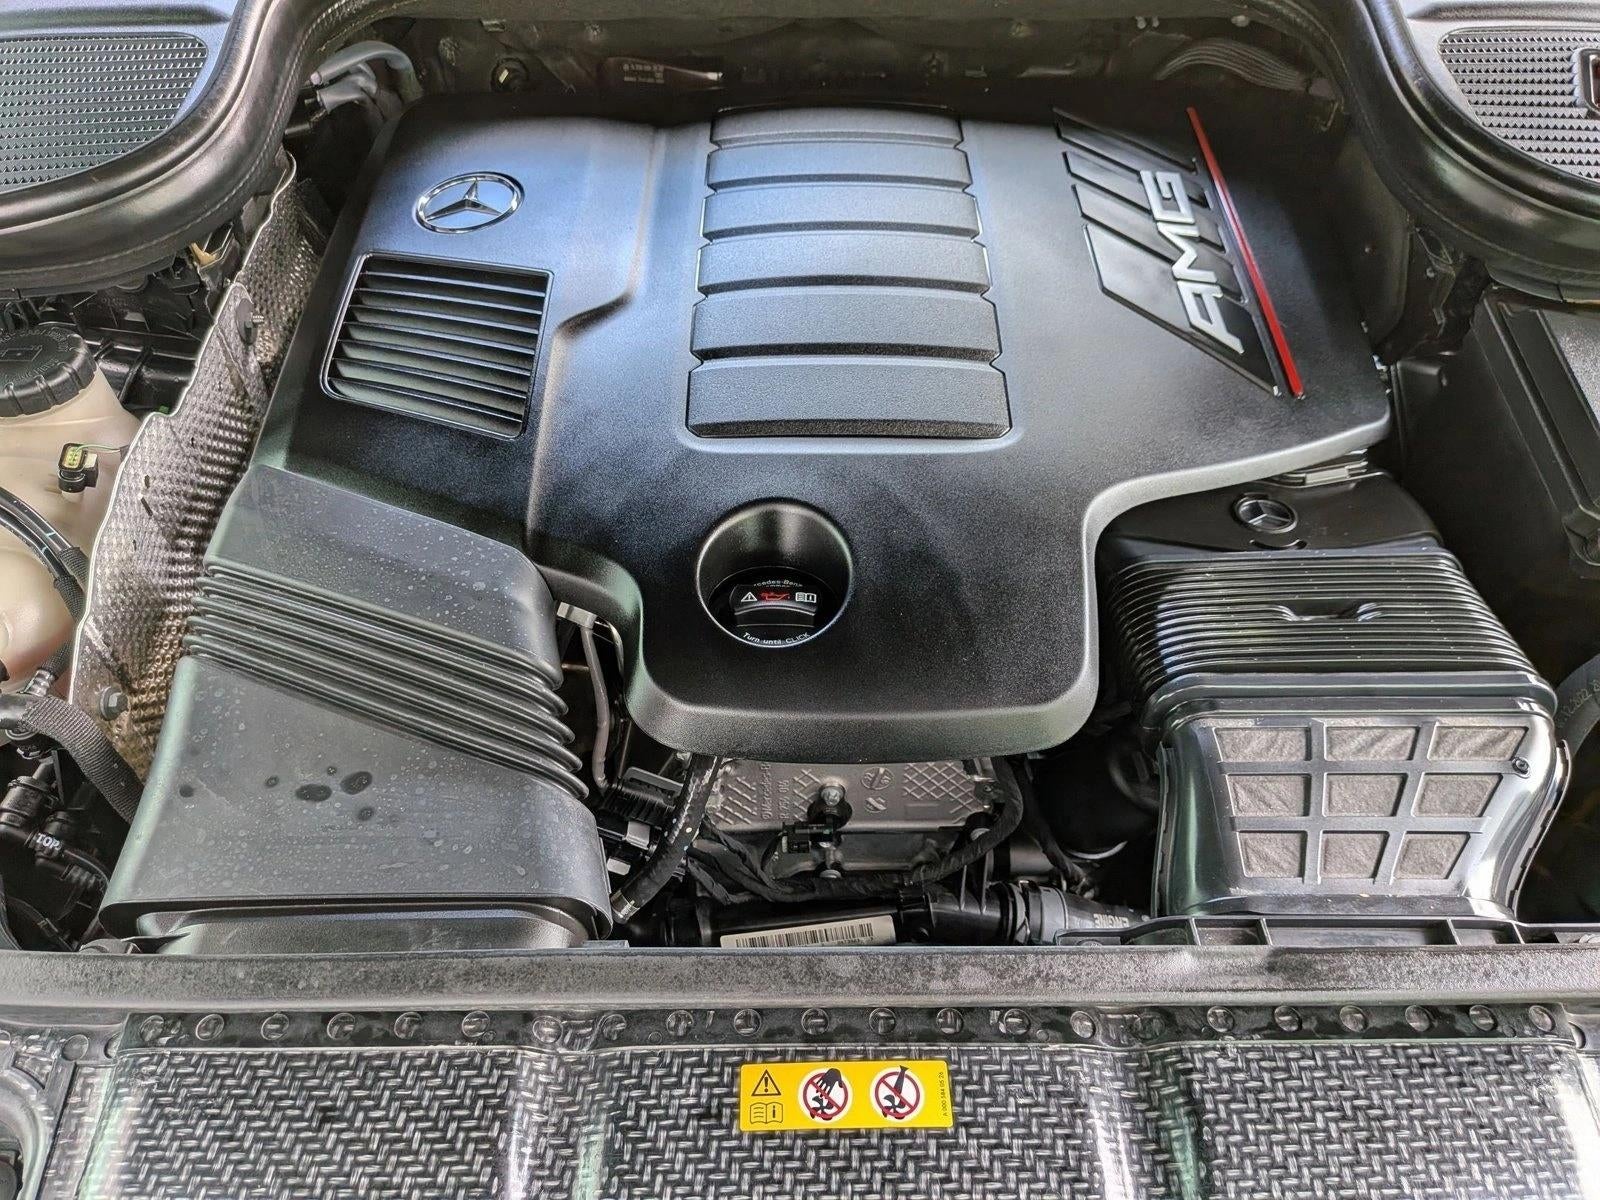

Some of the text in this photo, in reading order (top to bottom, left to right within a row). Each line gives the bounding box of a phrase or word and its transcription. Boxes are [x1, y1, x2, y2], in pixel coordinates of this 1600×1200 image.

[1140, 170, 1245, 354] AMG
[743, 631, 760, 643] Turn
[785, 631, 811, 645] CLICK
[36, 832, 60, 849] TOP
[1093, 913, 1130, 929] ENGINE
